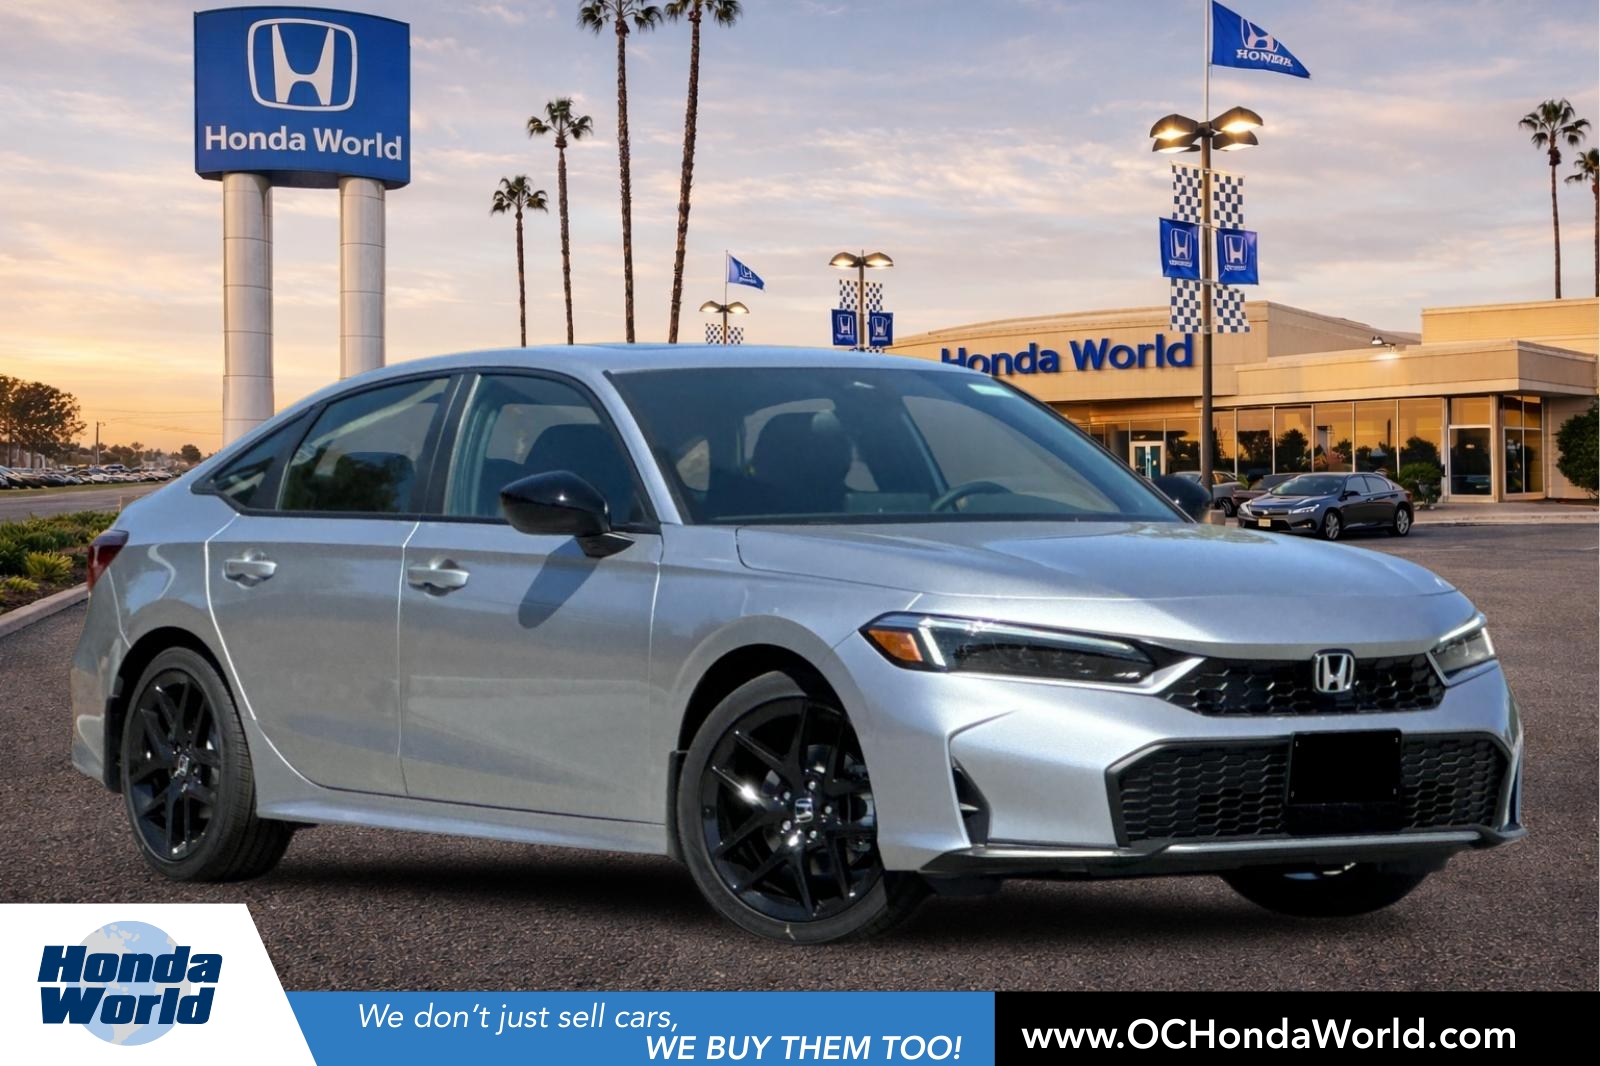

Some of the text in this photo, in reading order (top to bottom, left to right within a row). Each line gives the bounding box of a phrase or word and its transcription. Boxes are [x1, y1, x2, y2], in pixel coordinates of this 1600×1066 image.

[205, 125, 402, 161] Honda World
[1069, 333, 1193, 371] World
